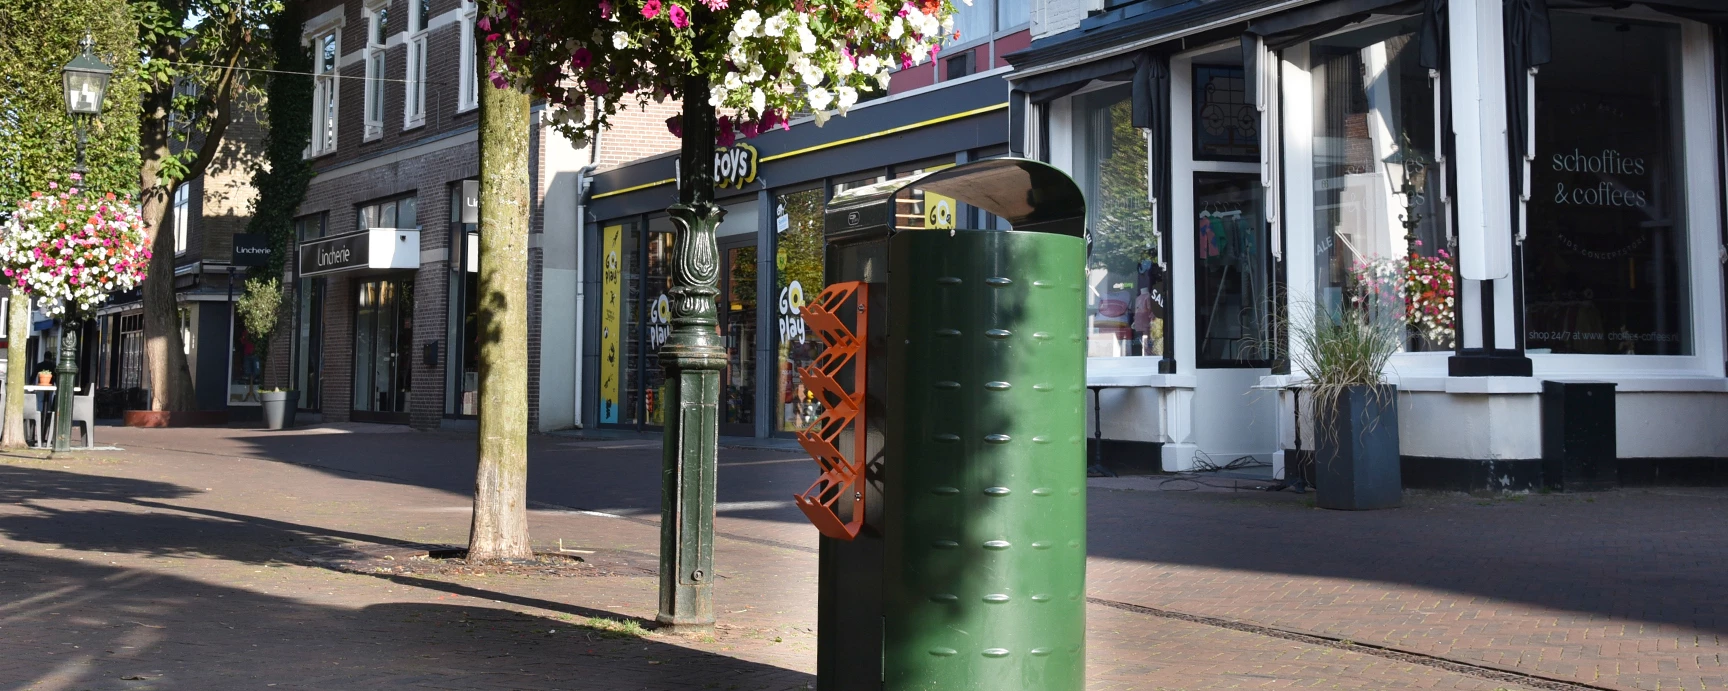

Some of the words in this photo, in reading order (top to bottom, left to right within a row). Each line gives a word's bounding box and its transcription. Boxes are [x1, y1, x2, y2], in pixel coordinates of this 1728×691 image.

[1552, 148, 1645, 175] schoffies
[1554, 182, 1570, 204] &
[1573, 181, 1646, 207] coffees
[236, 245, 272, 255] Lincherie
[1316, 235, 1333, 256] ALE
[1558, 233, 1578, 251] KIDS
[317, 244, 351, 267] Lincherie
[1151, 289, 1164, 308] SAL
[779, 315, 806, 345] play
[1528, 331, 1549, 341] shop
[1551, 331, 1571, 341] 24/7
[1573, 331, 1581, 340] at
